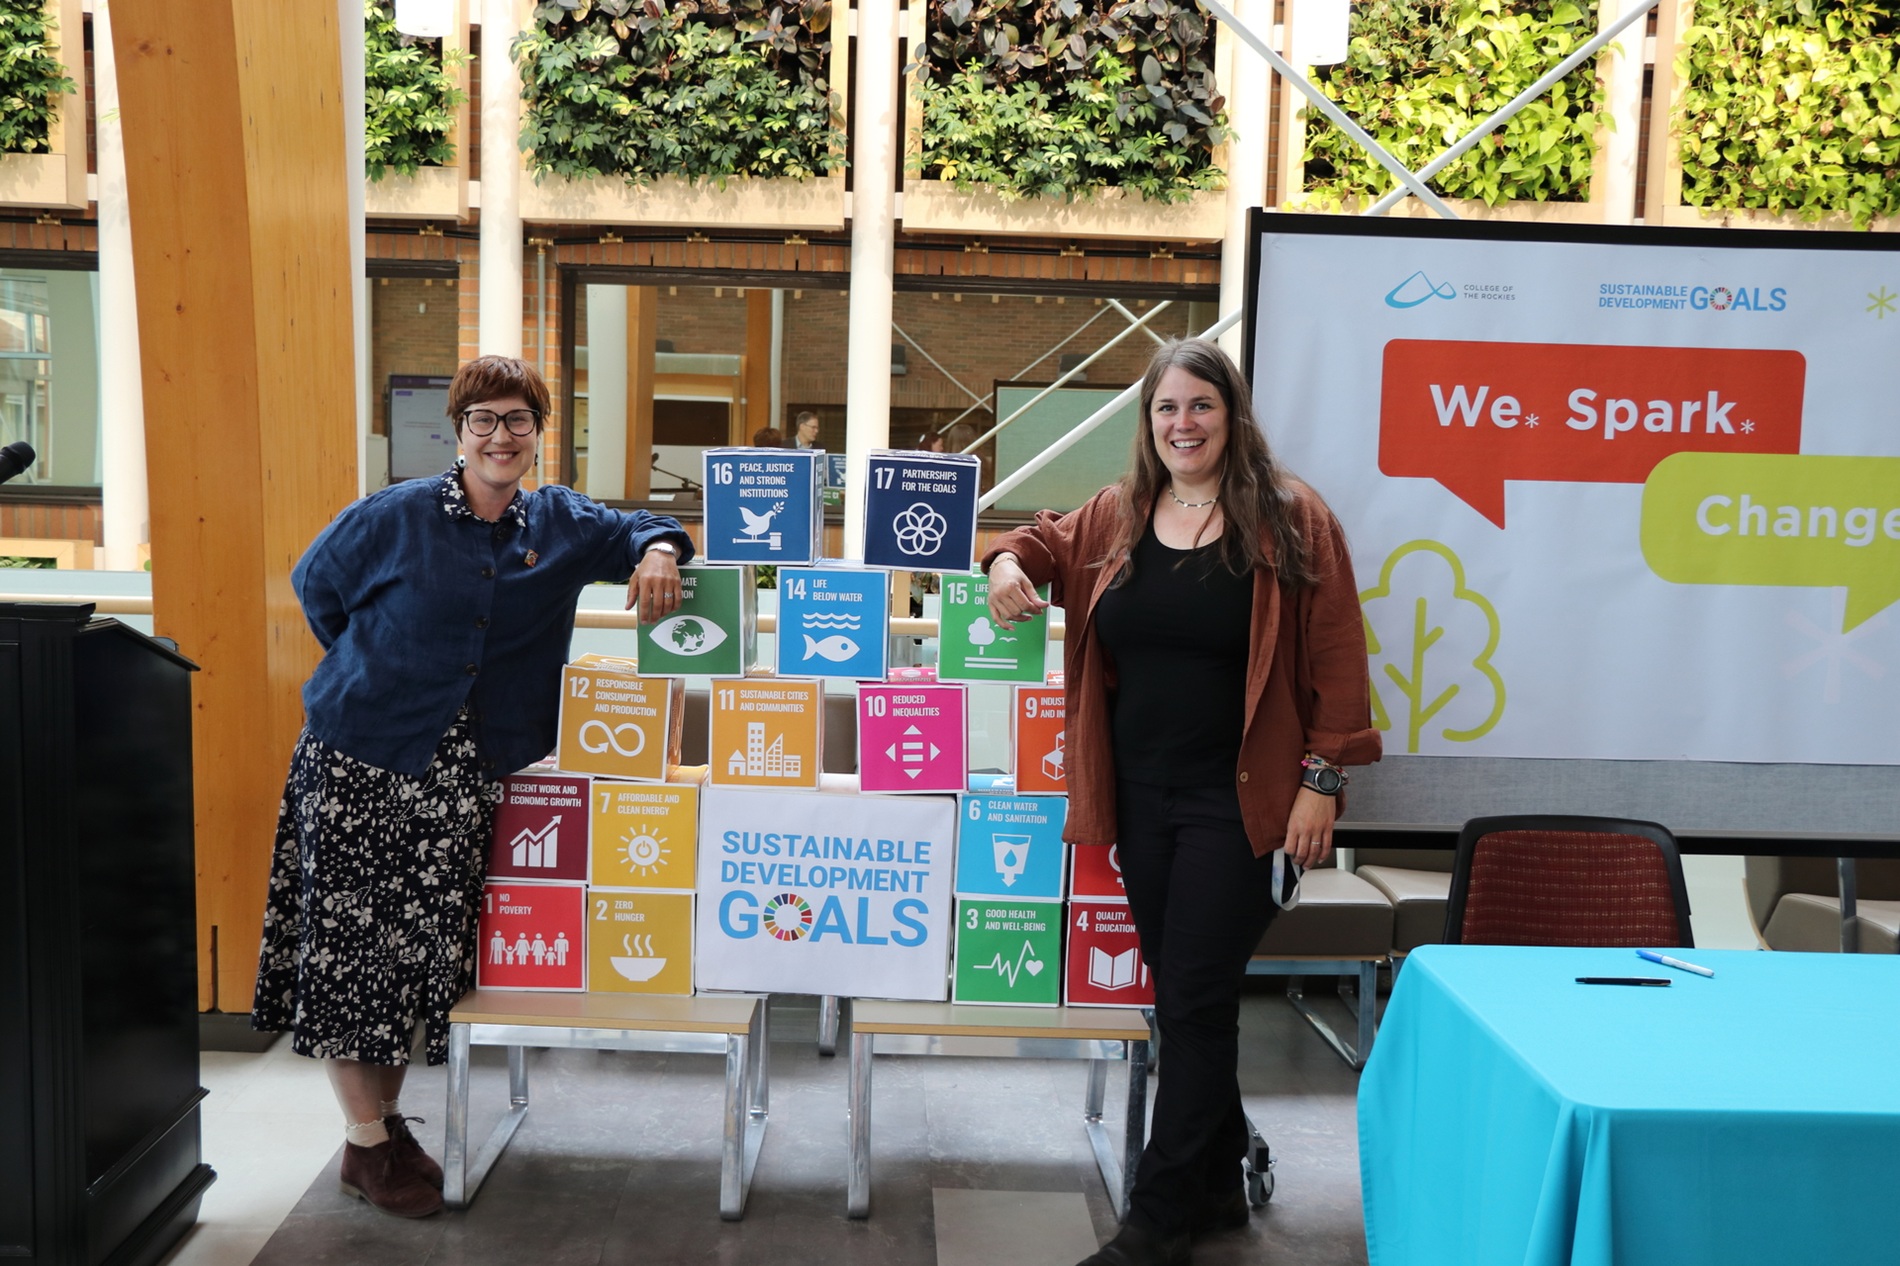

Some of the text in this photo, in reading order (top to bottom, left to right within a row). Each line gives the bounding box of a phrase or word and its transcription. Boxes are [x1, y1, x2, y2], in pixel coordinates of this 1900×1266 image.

[1464, 284, 1500, 292] COLLEGE
[1600, 283, 1688, 296] SUSTAINABLE
[1464, 292, 1478, 300] THE
[1690, 286, 1787, 312] GOALS
[1598, 297, 1687, 310] DEVELOPMENT
[712, 462, 733, 485] 16
[740, 463, 794, 474] PEACE, JUSTICE
[874, 467, 895, 490] 17
[902, 468, 958, 481] PARTNERSHIPS
[740, 476, 786, 486] AND STRONG
[740, 488, 788, 498] INSTITUTIONS
[902, 482, 957, 494] FOR THE GOALS
[786, 578, 806, 600] 14
[813, 579, 828, 588] LIFE
[975, 584, 989, 592] LIFE
[812, 592, 863, 602] BELOW WATER
[947, 582, 968, 605] 15
[974, 596, 985, 605] ON
[570, 676, 590, 698] 12
[596, 678, 644, 691] RESPONSIBLE
[595, 691, 646, 704] CONSUMPTION
[718, 689, 734, 710] 11
[740, 690, 808, 700] SUSTAINABLE CITIES
[892, 695, 926, 704] REDUCED
[740, 702, 804, 712] AND COMMUNITIES
[865, 695, 886, 717] 10
[1026, 696, 1038, 718] 9
[1040, 697, 1064, 706] INDUST
[594, 704, 656, 716] AND PRODUCTION
[892, 707, 940, 718] INEQUALITIES
[1040, 709, 1055, 718] AND
[510, 783, 578, 794] DECENT WORK AND
[510, 796, 582, 807] ECONOMIC GROWTH
[600, 792, 611, 814] 7
[618, 793, 680, 804] AFFORDABLE AND
[618, 805, 670, 816] CLEAN ENERGY
[968, 799, 981, 820] 6
[988, 800, 1038, 812] CLEAN WATER
[987, 812, 1048, 824] AND SANITATION
[722, 830, 932, 864] SUSTAINABLE
[721, 860, 930, 893] DEVELOPMENT
[499, 893, 510, 902] NO
[485, 893, 493, 914] 1
[614, 900, 634, 910] ZERO
[499, 905, 532, 915] POVERTY
[596, 900, 608, 921] 2
[986, 909, 1036, 919] GOOD HEALTH
[614, 912, 645, 922] HUNGER
[718, 890, 929, 948] GOALS
[966, 908, 979, 930] 3
[1076, 910, 1089, 932] 4
[1096, 911, 1126, 922] QUALITY
[985, 922, 1046, 932] AND WELL-BEING
[1095, 924, 1136, 934] EDUCATION
